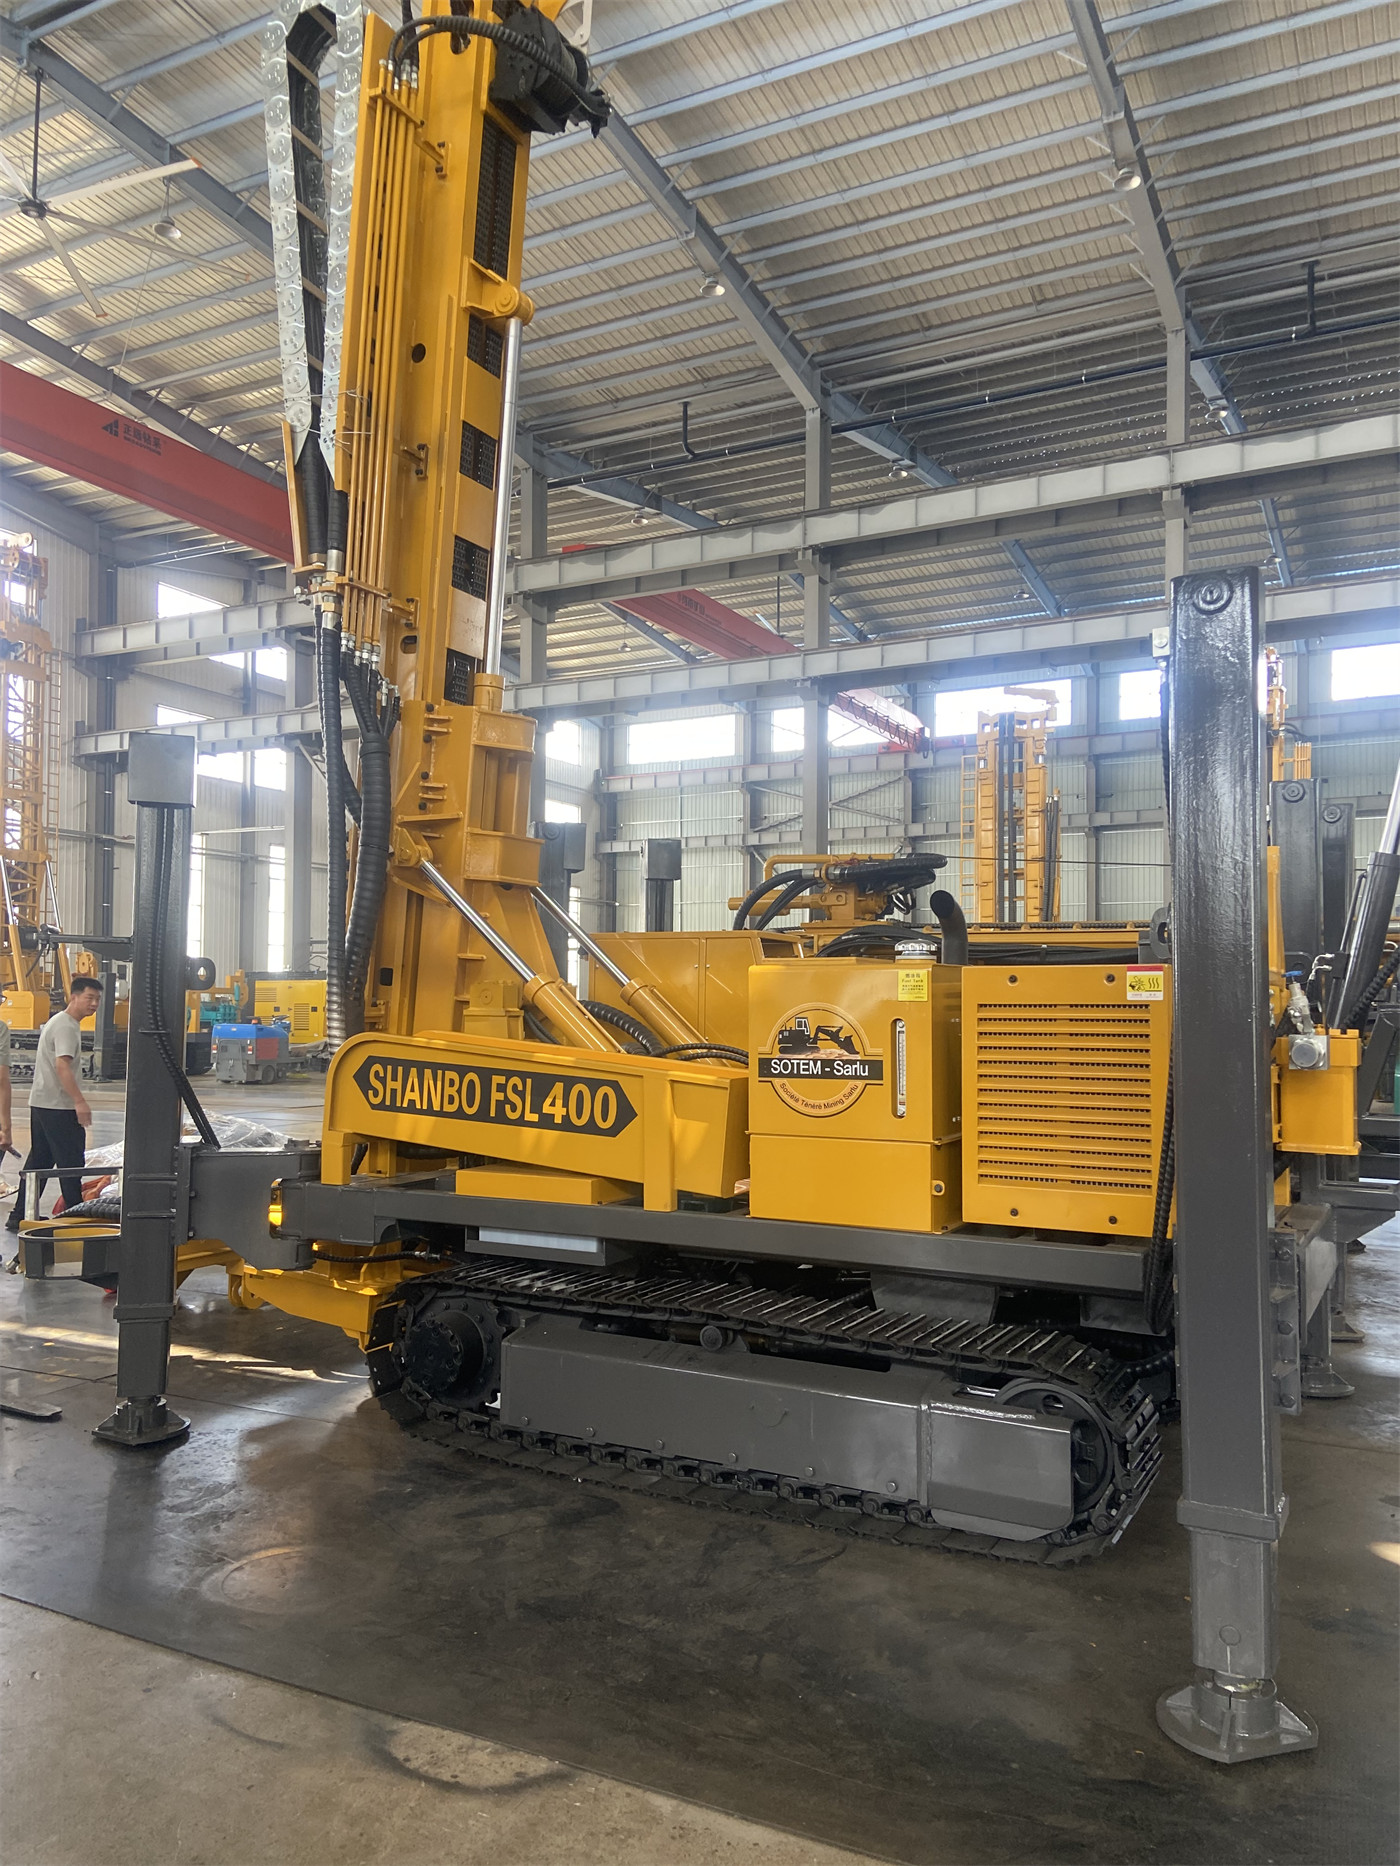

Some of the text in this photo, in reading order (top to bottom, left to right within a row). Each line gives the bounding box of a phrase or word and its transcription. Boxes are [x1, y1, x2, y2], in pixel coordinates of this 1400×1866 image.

[771, 1059, 822, 1075] SOTEM
[833, 1060, 869, 1076] Sarlu
[368, 1063, 481, 1115] SHANBO
[824, 1098, 845, 1110] Mining
[842, 1084, 859, 1100] Sarlu
